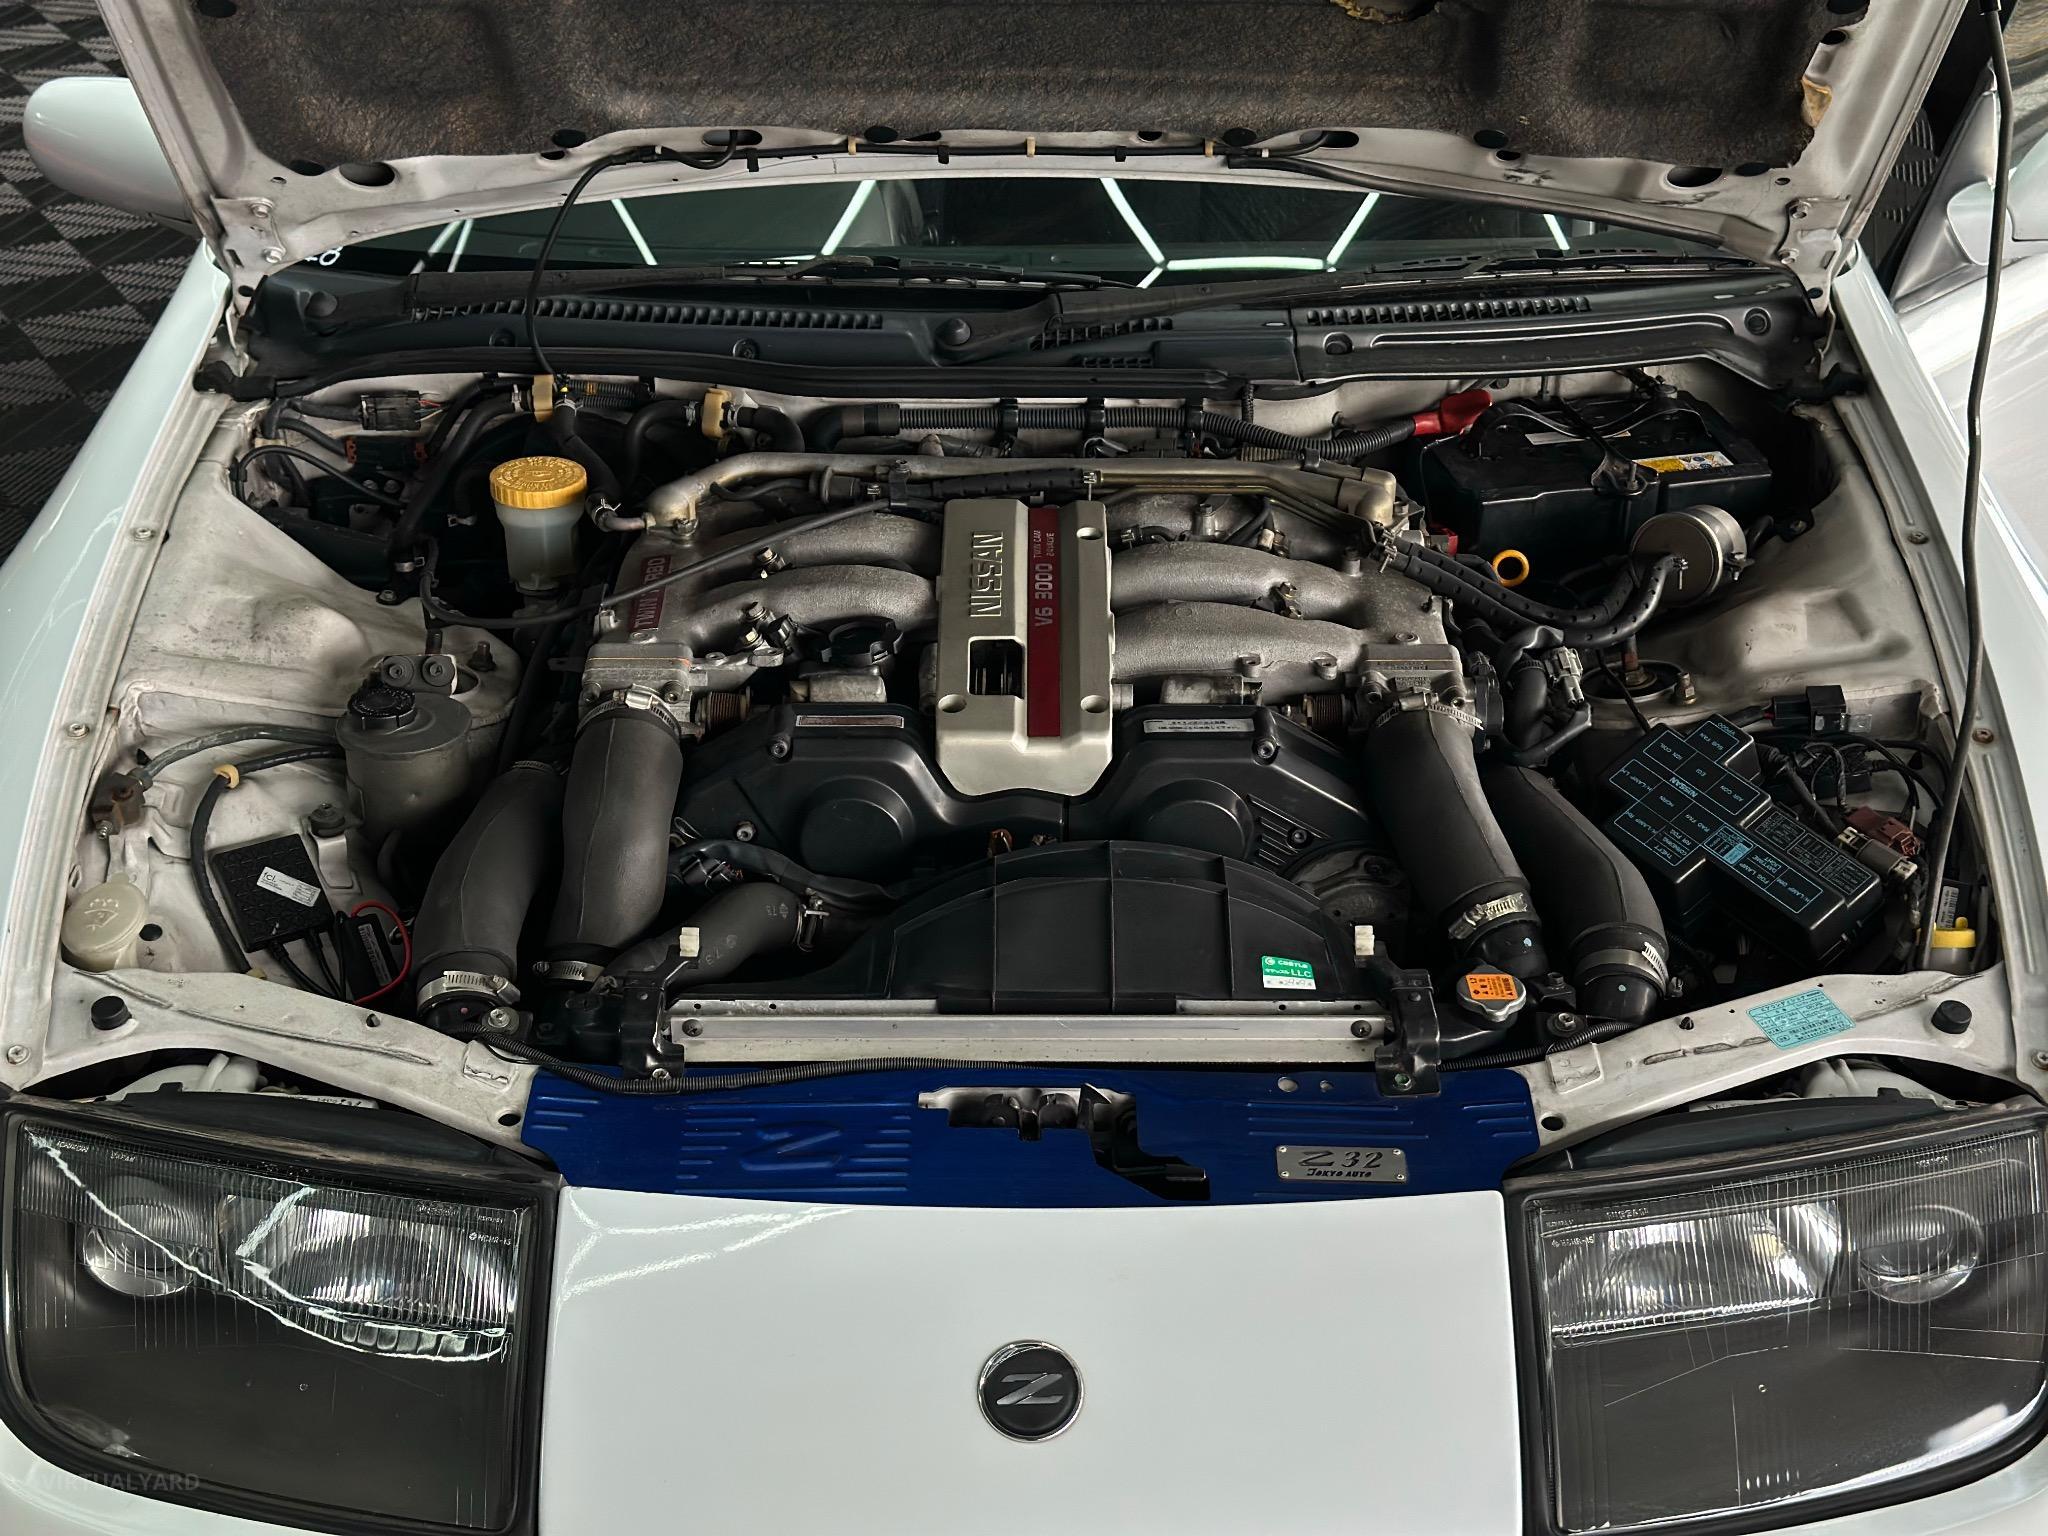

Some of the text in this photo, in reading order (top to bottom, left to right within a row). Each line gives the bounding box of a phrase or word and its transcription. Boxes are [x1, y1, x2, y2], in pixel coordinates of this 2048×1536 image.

[970, 531, 1003, 617] NISSAN
[1035, 563, 1053, 626] V6 3000
[634, 596, 658, 628] TWIN
[1668, 776, 1698, 797] NISSAN
[1290, 968, 1311, 977] LLC
[1342, 1152, 1383, 1168] 32
[997, 1373, 1063, 1405] Z
